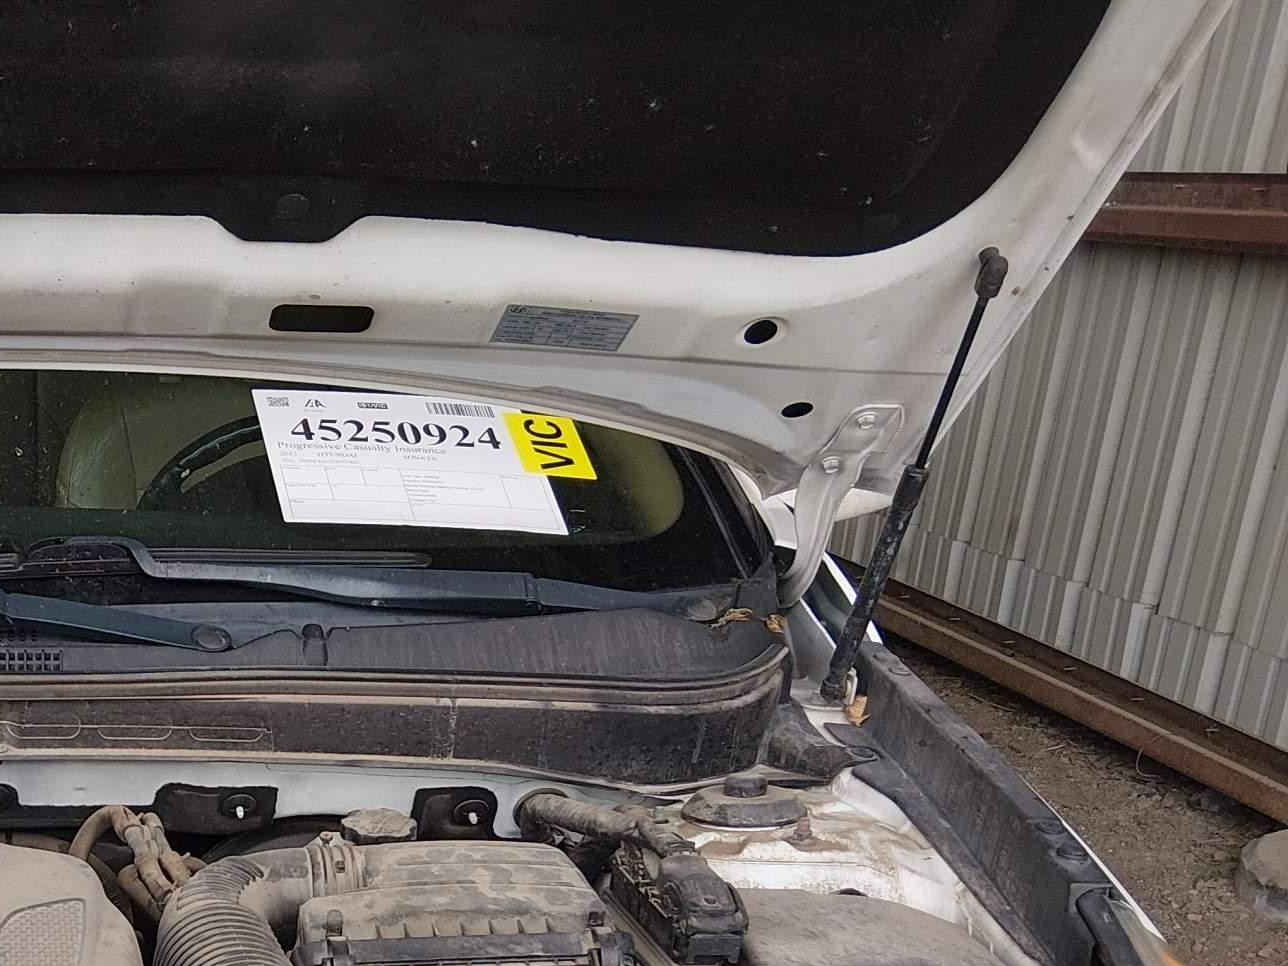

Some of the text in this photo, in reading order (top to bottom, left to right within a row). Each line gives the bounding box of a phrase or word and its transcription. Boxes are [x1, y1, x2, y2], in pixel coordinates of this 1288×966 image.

[276, 441, 448, 455] Progressive Casualty Insurance
[291, 417, 502, 450] 45250924
[524, 418, 575, 471] VIC
